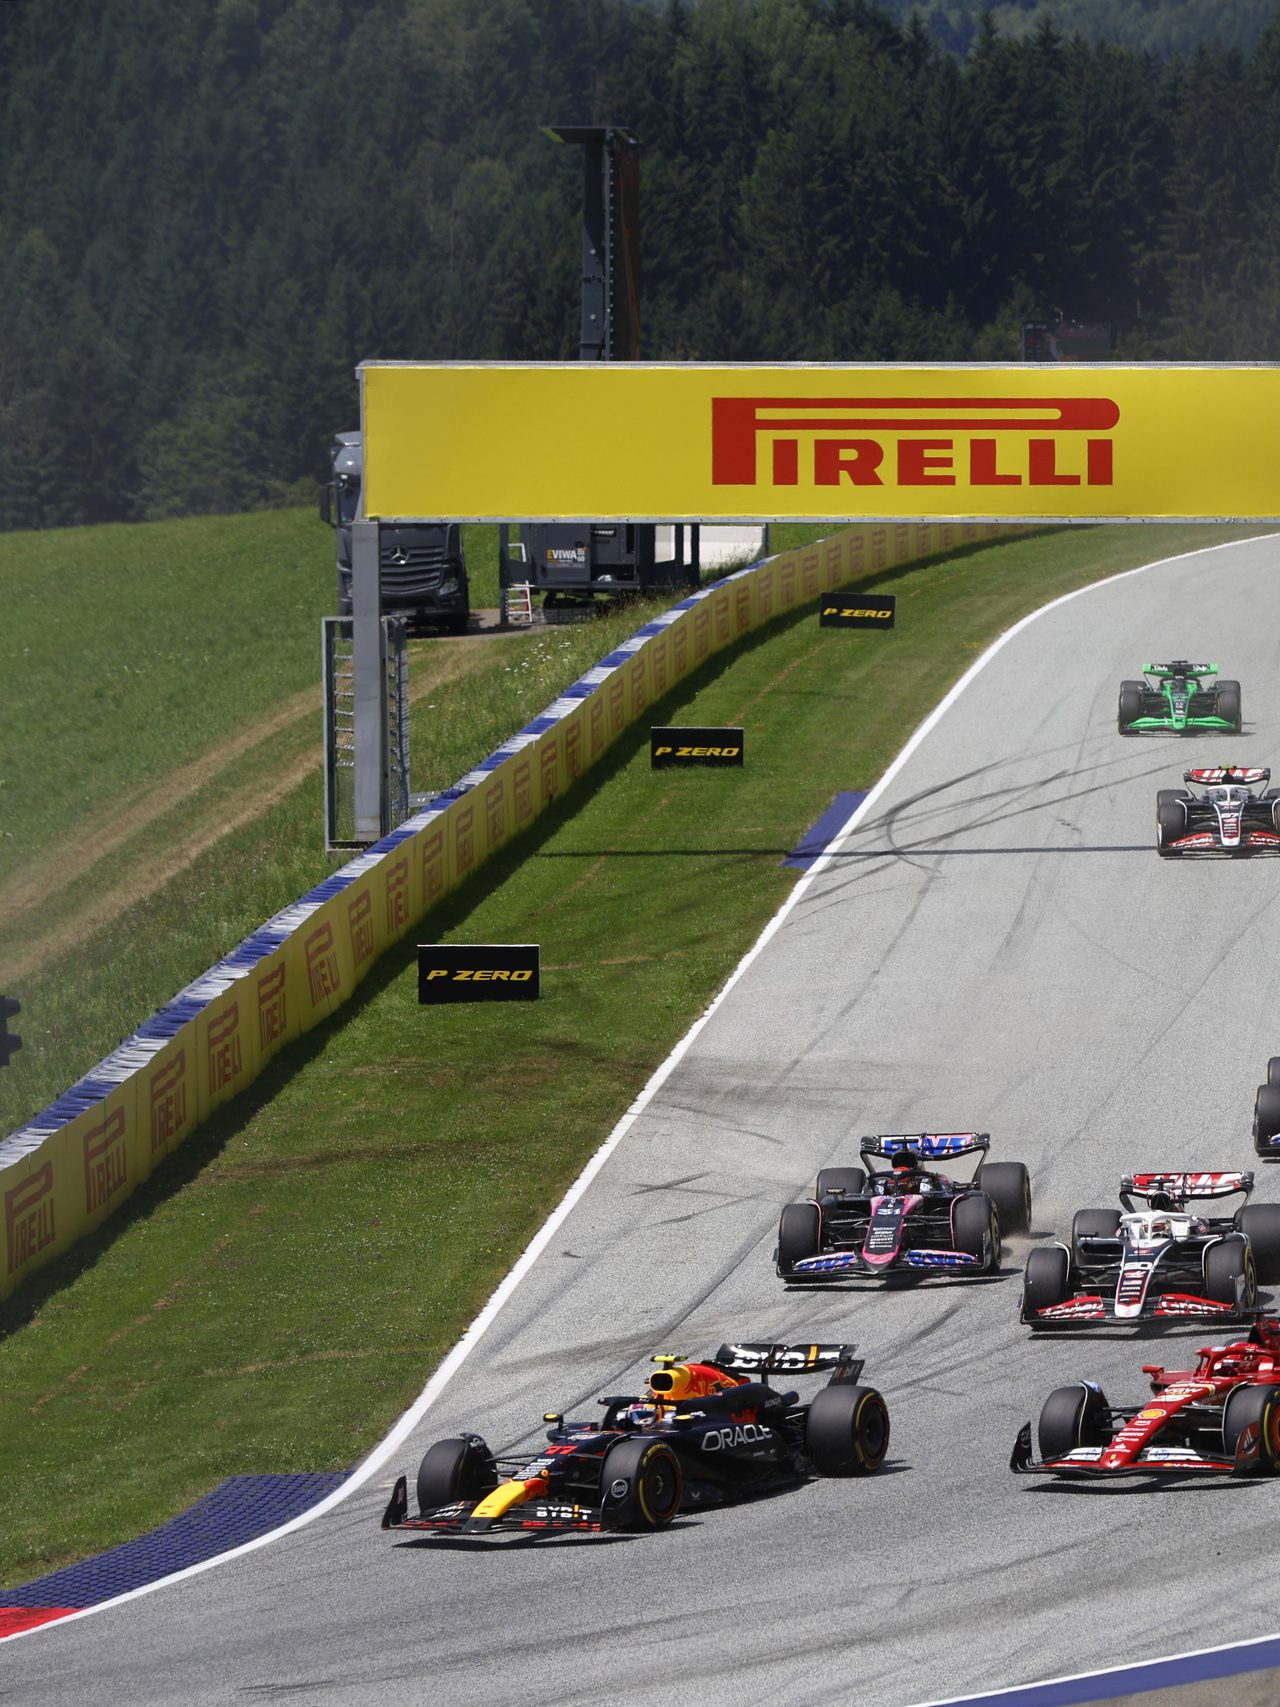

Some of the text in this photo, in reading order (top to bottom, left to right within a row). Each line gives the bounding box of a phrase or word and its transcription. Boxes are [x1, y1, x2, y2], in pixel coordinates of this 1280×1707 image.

[712, 398, 1120, 486] PIRELLI
[823, 608, 891, 619] P ZERO
[655, 746, 740, 757] P ZERO
[426, 970, 533, 981] P ZERO
[83, 1104, 128, 1215] PIRELLI
[4, 1159, 56, 1276] PIRELLI
[702, 1425, 772, 1451] ORACLE
